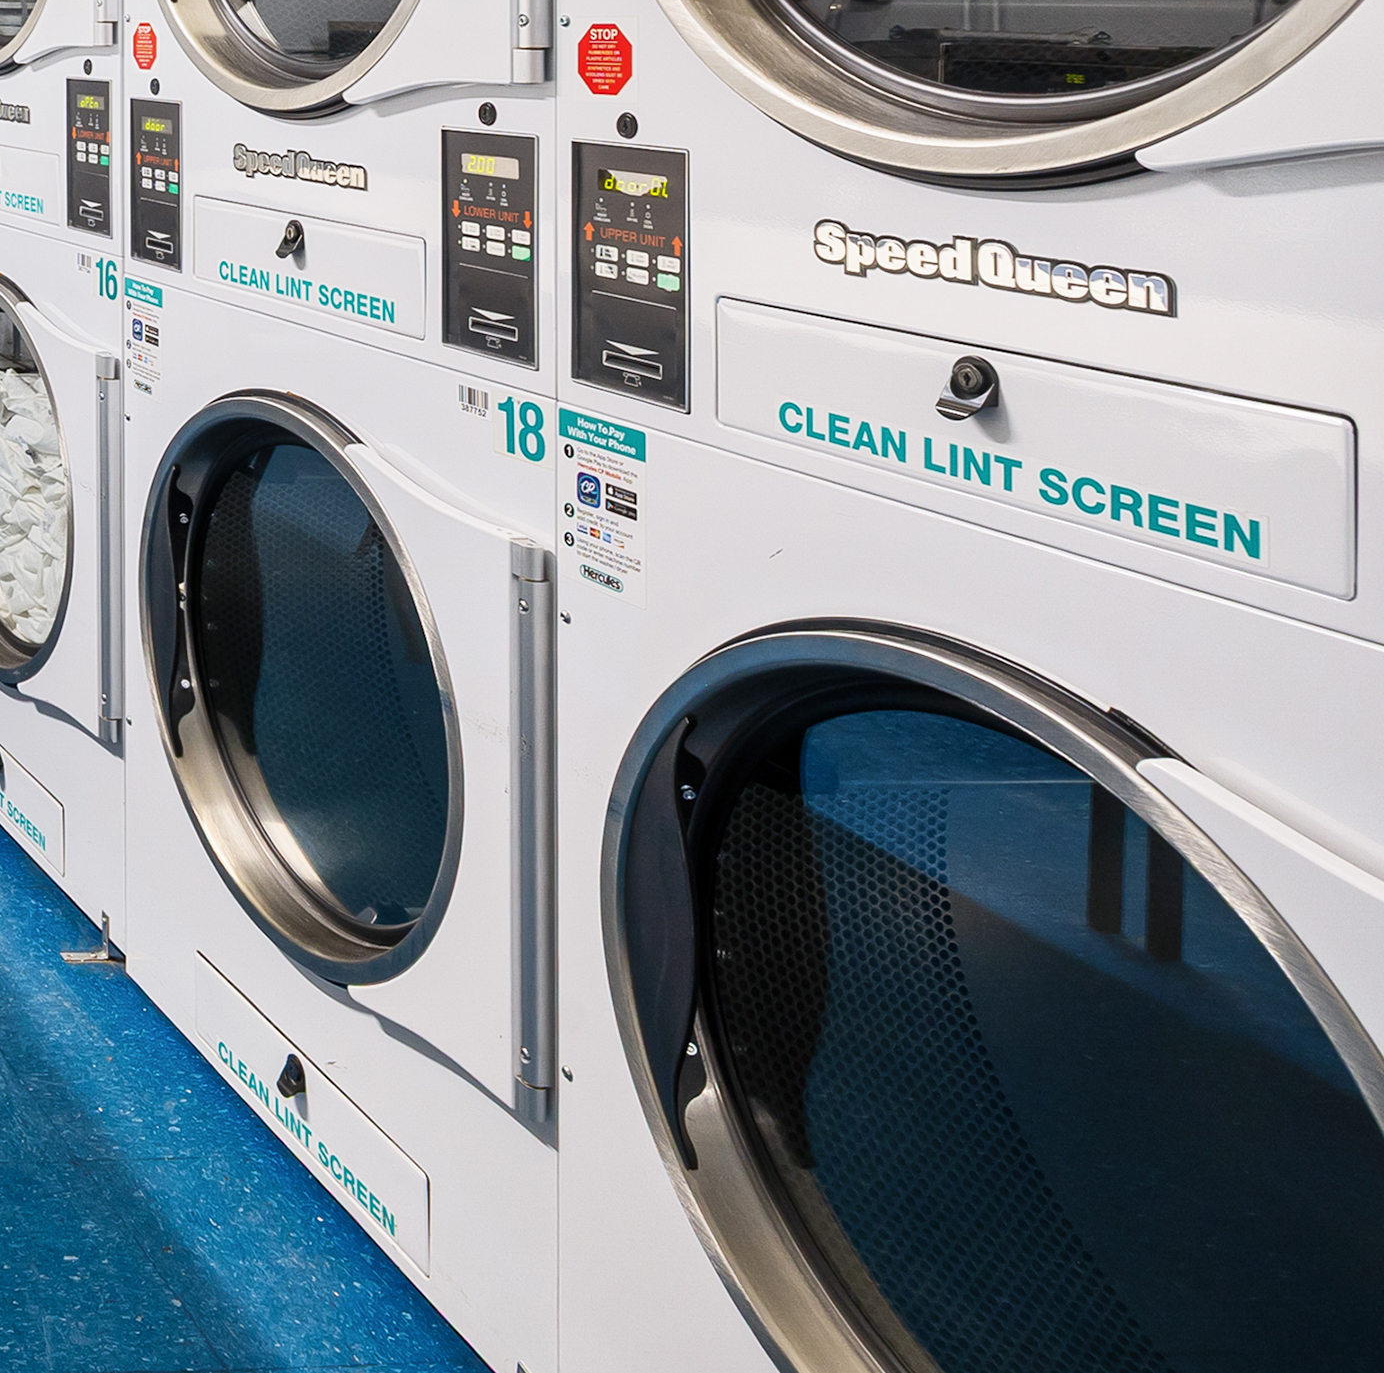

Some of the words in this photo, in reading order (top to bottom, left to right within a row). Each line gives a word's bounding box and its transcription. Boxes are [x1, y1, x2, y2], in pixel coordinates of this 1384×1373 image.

[590, 28, 618, 40] STOP
[233, 143, 295, 178] Speed
[295, 150, 368, 191] Queen
[4, 193, 44, 215] SCREEN
[463, 205, 496, 220] LOWER
[498, 210, 520, 223] UNIT
[600, 227, 637, 244] UPPER
[640, 233, 666, 248] UNIT
[96, 257, 118, 301] 16
[814, 218, 979, 279] Speed
[977, 239, 1178, 318] Queen
[219, 260, 270, 291] CLEAN
[276, 273, 312, 301] LINT
[318, 284, 395, 323] SCREEN
[498, 396, 545, 462] 18
[567, 426, 587, 439] With
[588, 432, 607, 446] Your
[608, 438, 637, 456] Phone
[577, 417, 597, 431] How
[598, 422, 608, 435] To
[608, 427, 625, 442] Pay
[778, 401, 907, 465] CLEAN
[923, 437, 1023, 494] LINT
[1038, 468, 1263, 561] SCREEN
[581, 566, 621, 591] Hercules
[7, 800, 46, 851] SCREEN
[218, 1042, 269, 1107] CLEAN
[275, 1096, 312, 1148] LINT
[318, 1141, 395, 1237] SCREEN
